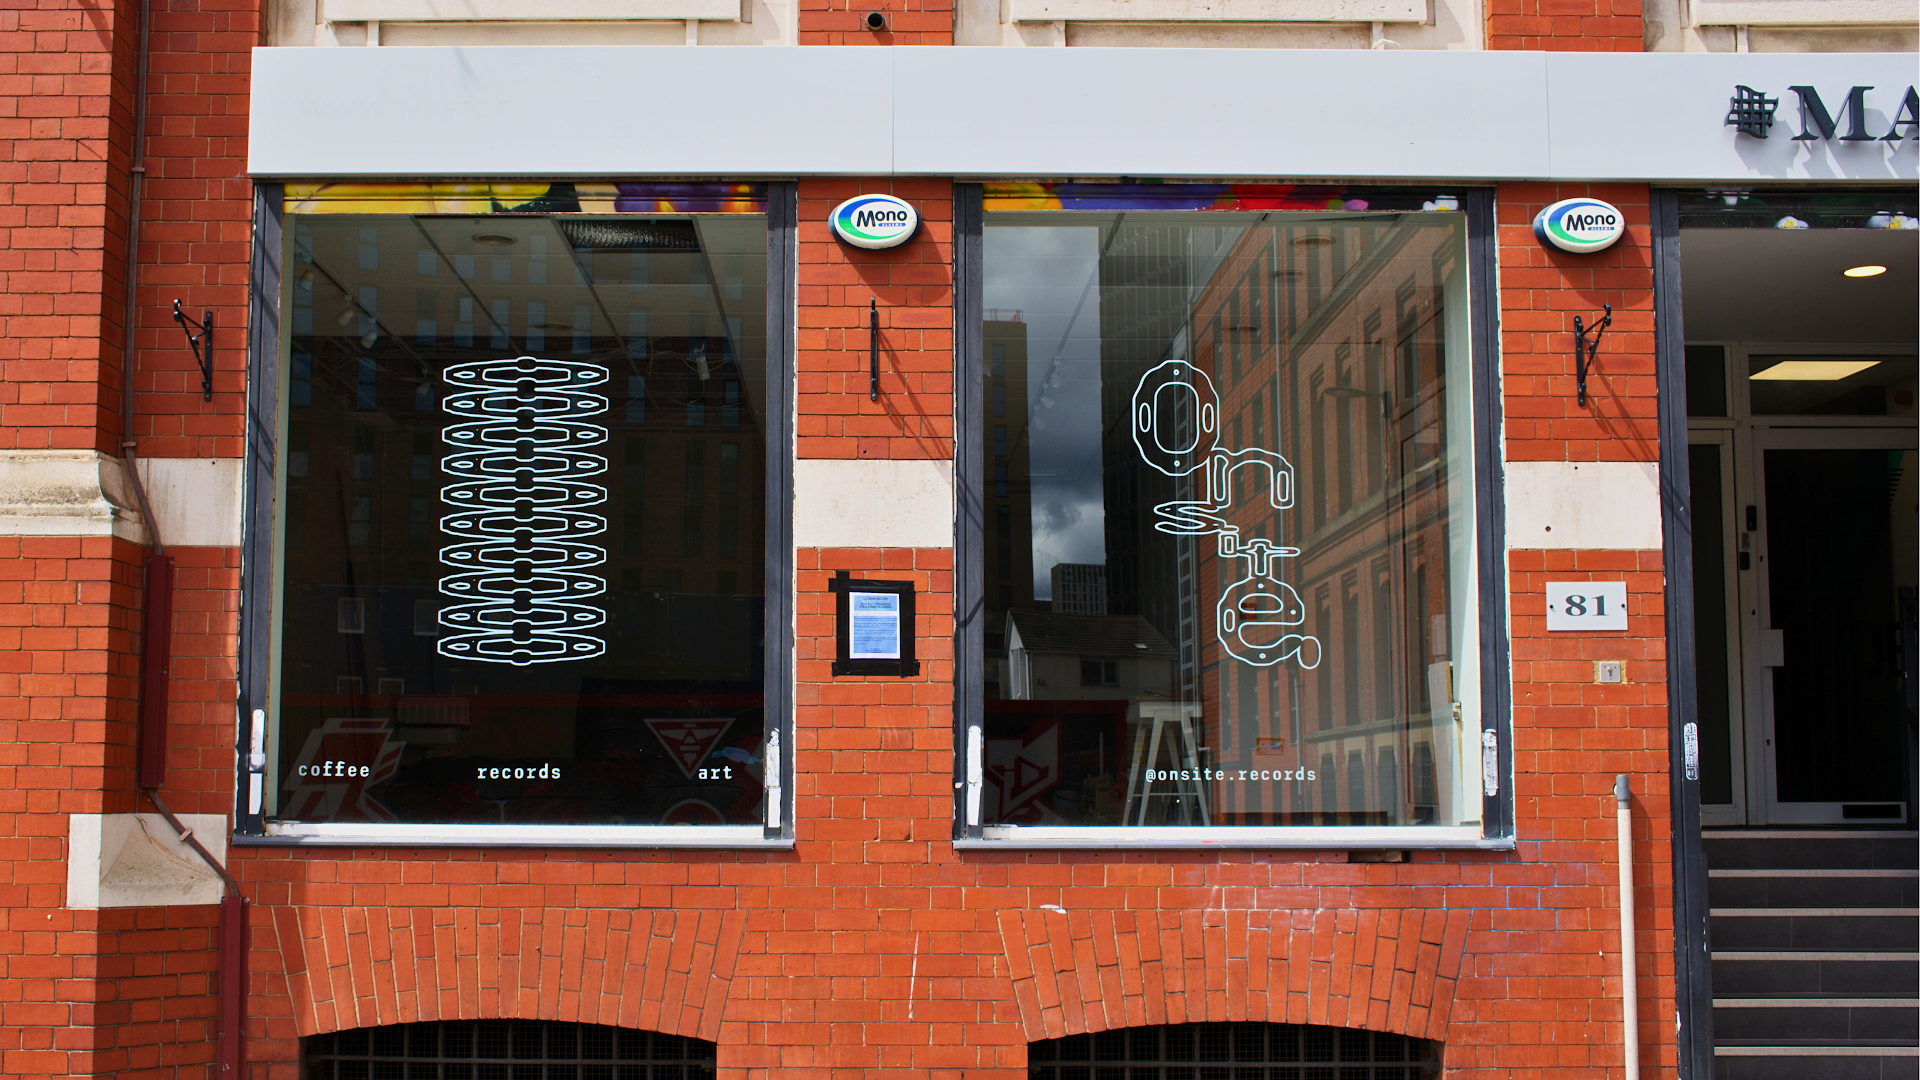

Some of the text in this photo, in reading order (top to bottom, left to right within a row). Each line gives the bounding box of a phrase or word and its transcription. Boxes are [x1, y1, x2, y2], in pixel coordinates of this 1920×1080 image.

[1787, 85, 1919, 141] MA
[857, 210, 908, 227] Mono
[1566, 214, 1616, 231] Mono
[1565, 594, 1609, 617] 81
[298, 760, 370, 778] coffee
[477, 763, 561, 779] records
[698, 765, 732, 780] art
[1145, 766, 1316, 782] @onsite.records
